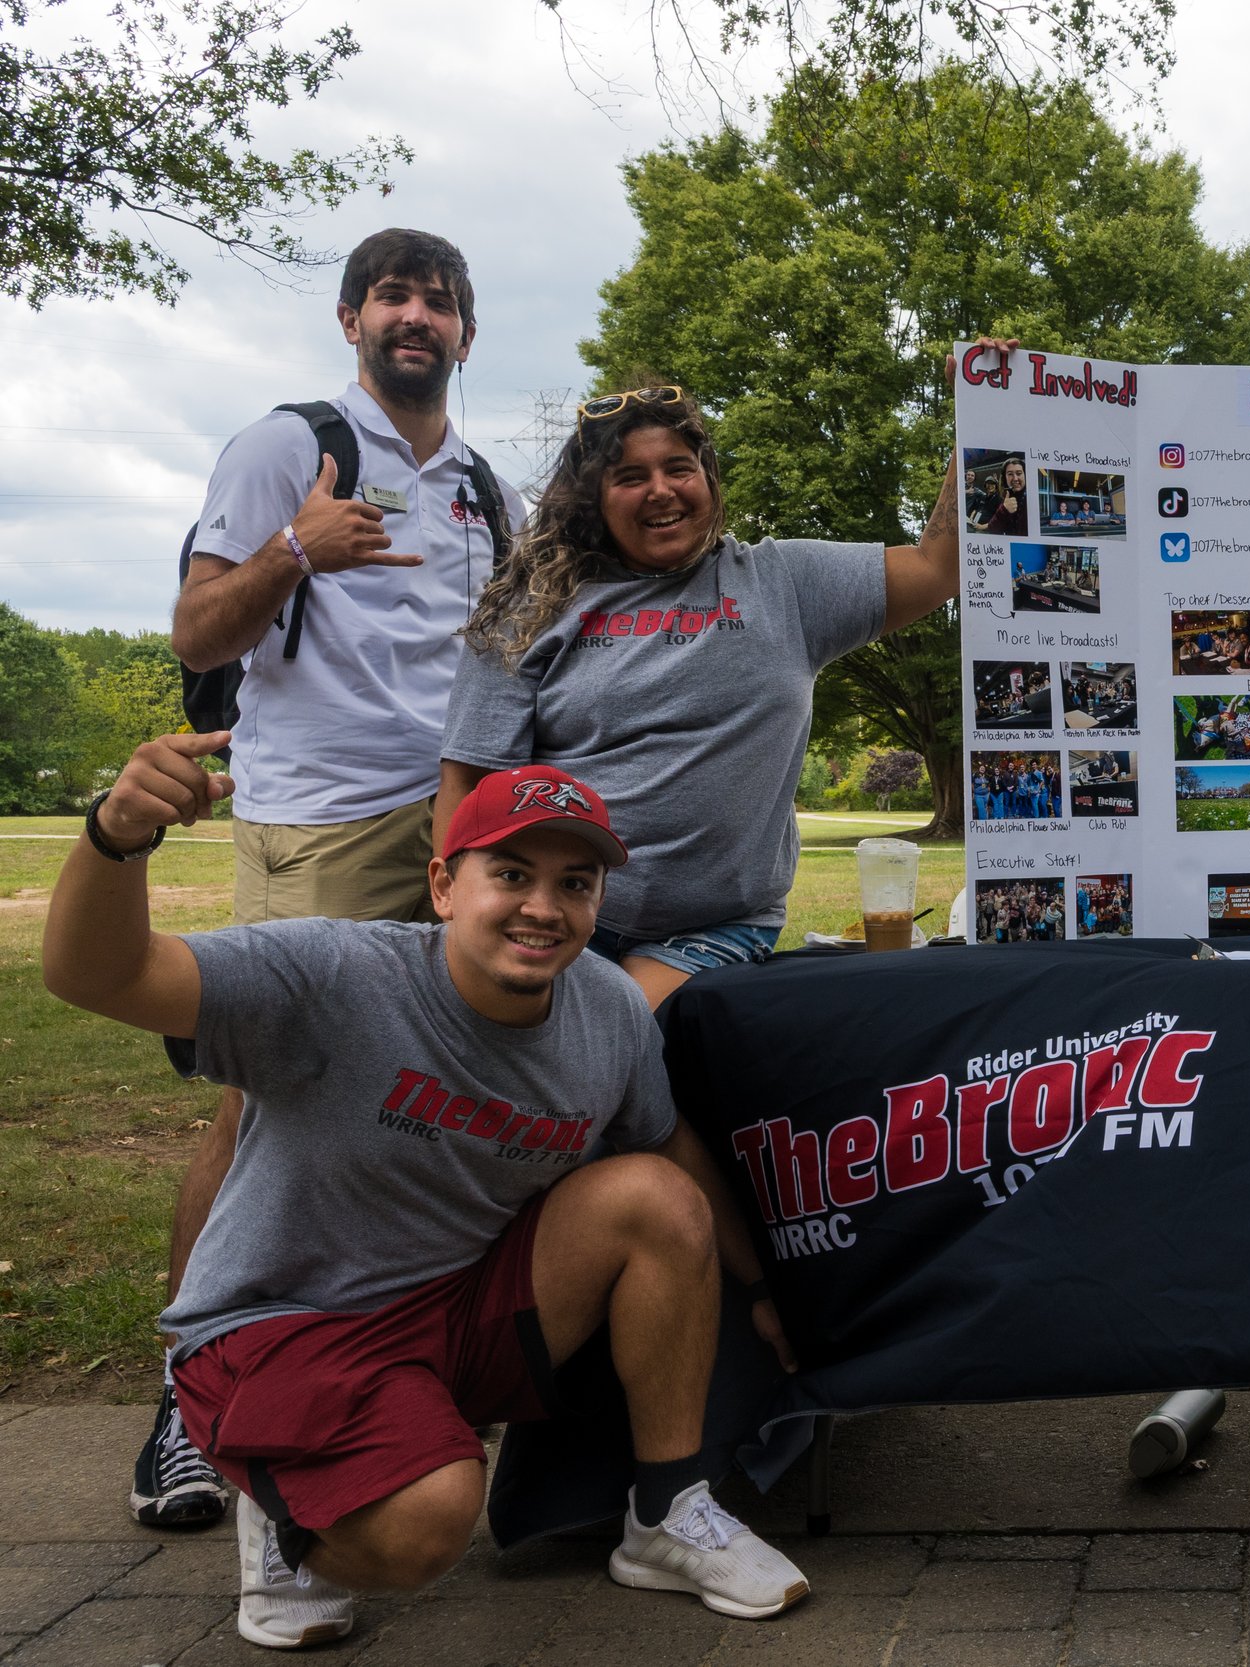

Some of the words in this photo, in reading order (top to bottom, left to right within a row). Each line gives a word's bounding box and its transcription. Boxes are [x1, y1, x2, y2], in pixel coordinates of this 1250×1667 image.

[962, 345, 1012, 390] Get
[1029, 353, 1137, 408] Involved!
[1030, 448, 1050, 461] Live
[1053, 450, 1080, 465] Sports
[1085, 452, 1131, 468] Broadcasts!
[967, 544, 980, 555] Red
[983, 544, 1005, 555] White
[967, 556, 984, 567] and
[986, 556, 1005, 566] Brew
[966, 590, 1005, 599] Insurance
[1163, 593, 1186, 608] Top
[717, 618, 746, 631] FM
[997, 629, 1031, 645] More
[1037, 630, 1056, 646] live
[1060, 631, 1118, 648] broadcasts!
[973, 730, 1021, 742] Philadelphia
[1038, 730, 1055, 740] Show!
[1062, 729, 1085, 738] Trenton
[970, 820, 1026, 834] Philadelphia
[1027, 821, 1049, 832] Flower
[1050, 820, 1071, 832] Show!
[1088, 819, 1107, 830] Club
[1112, 819, 1127, 830] Pub!
[976, 850, 1036, 870] Executive
[1045, 852, 1081, 869] Staff!
[966, 1046, 1039, 1081] Rider
[1044, 1011, 1180, 1060] University
[378, 1109, 442, 1142] WRRC
[731, 1030, 1217, 1225] TheBronc
[1102, 1111, 1195, 1152] FM
[493, 1144, 550, 1164] 107.7
[554, 1151, 582, 1165] FM
